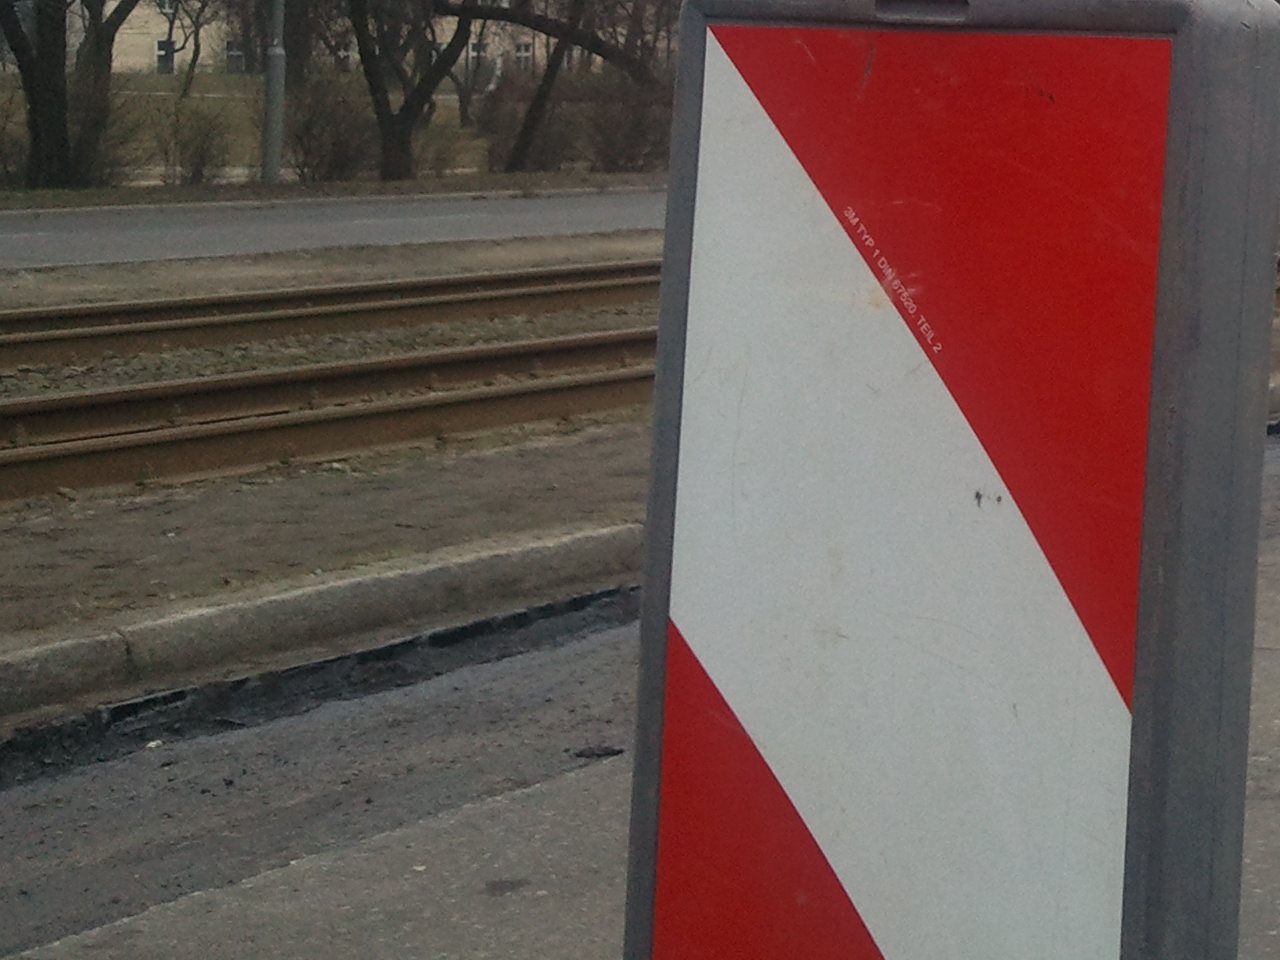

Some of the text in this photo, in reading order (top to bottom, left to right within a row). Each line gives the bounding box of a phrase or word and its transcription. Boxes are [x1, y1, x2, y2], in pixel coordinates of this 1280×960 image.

[843, 206, 860, 226] 3M
[857, 224, 875, 247] TYP
[873, 249, 880, 258] 1
[877, 257, 896, 280] DIN
[917, 315, 936, 344] TEIL
[933, 343, 943, 354] 2
